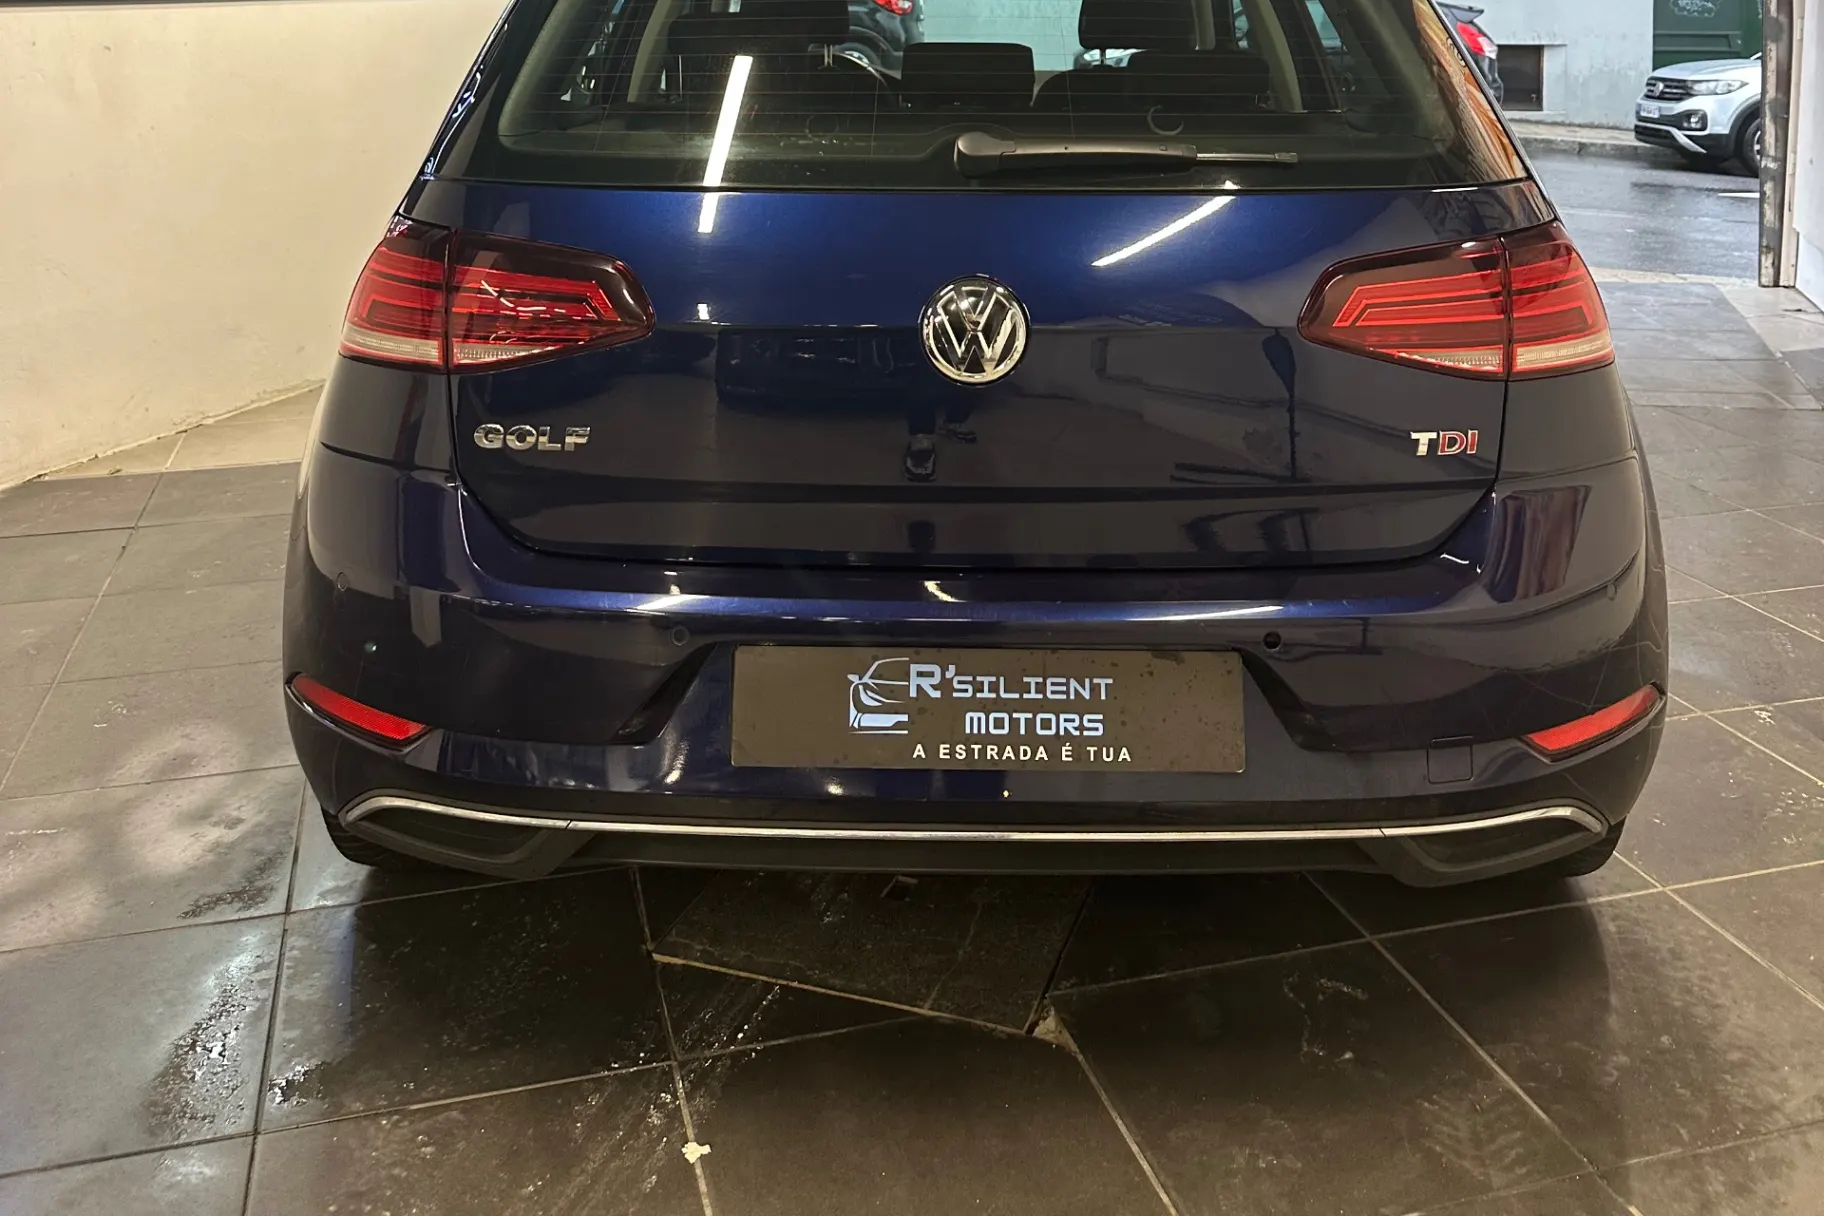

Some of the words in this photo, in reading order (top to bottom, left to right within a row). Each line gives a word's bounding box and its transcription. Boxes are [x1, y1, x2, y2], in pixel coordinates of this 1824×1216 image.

[473, 423, 591, 451] GOLF
[1410, 429, 1479, 456] TDI
[909, 663, 1114, 700] R'SILIENT
[965, 712, 1104, 736] MOTORS
[912, 744, 926, 759] A
[939, 744, 1049, 761] ESTRADA
[1061, 742, 1073, 761] É
[1086, 746, 1132, 762] TUA
